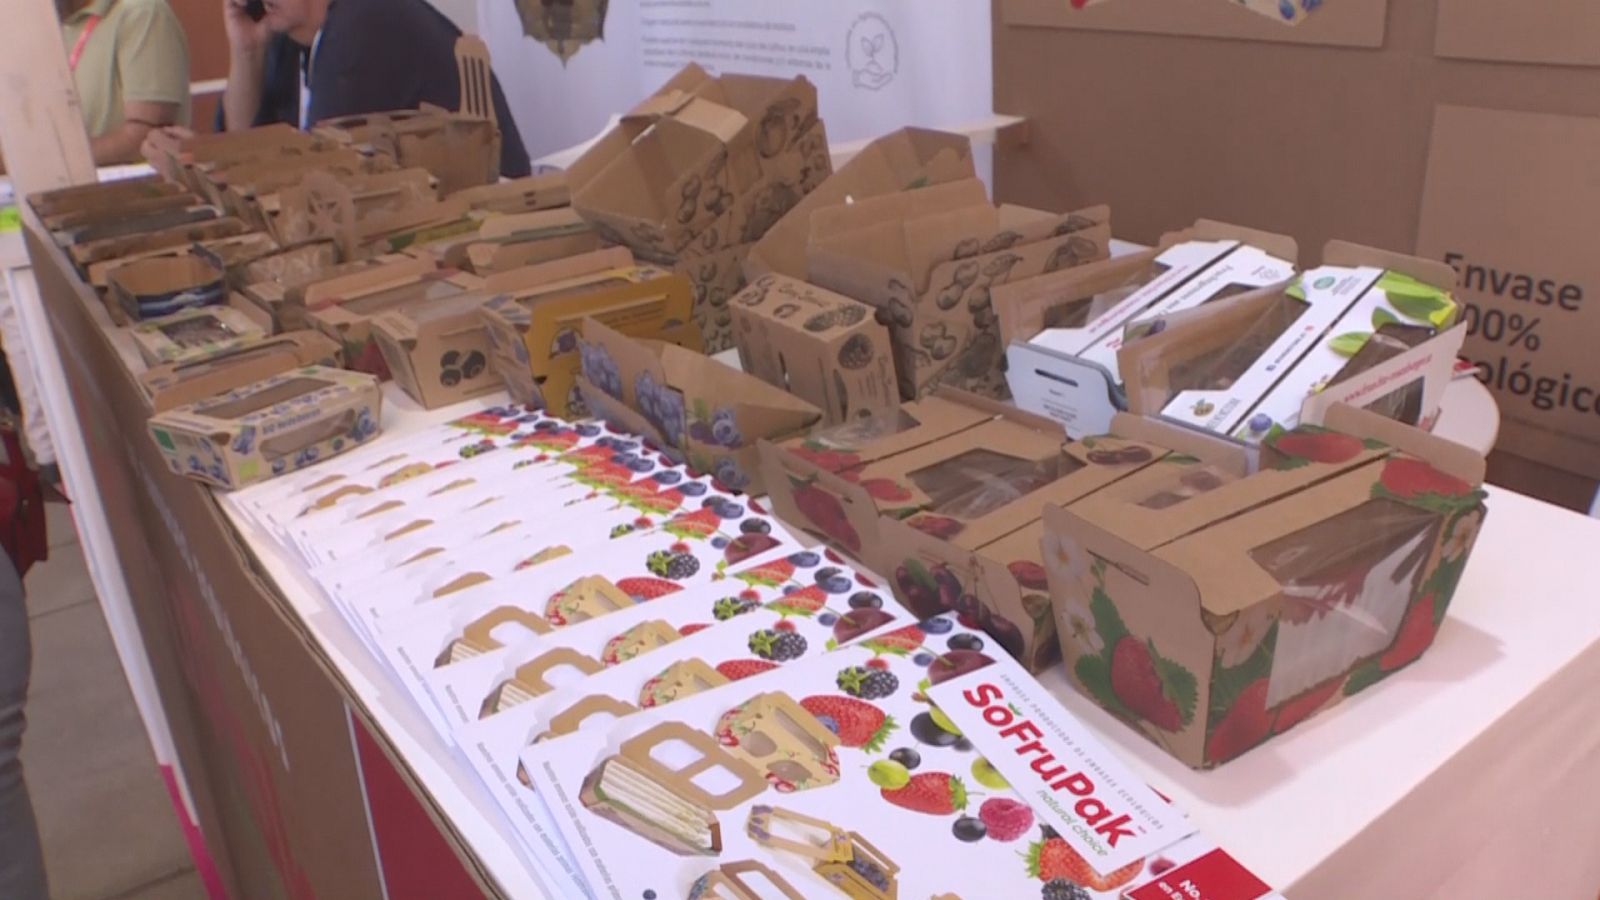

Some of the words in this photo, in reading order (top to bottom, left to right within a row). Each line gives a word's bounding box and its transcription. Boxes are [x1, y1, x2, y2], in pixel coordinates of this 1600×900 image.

[963, 682, 1137, 849] SoFruPak
[1036, 790, 1078, 825] natural
[1072, 824, 1108, 856] choice
